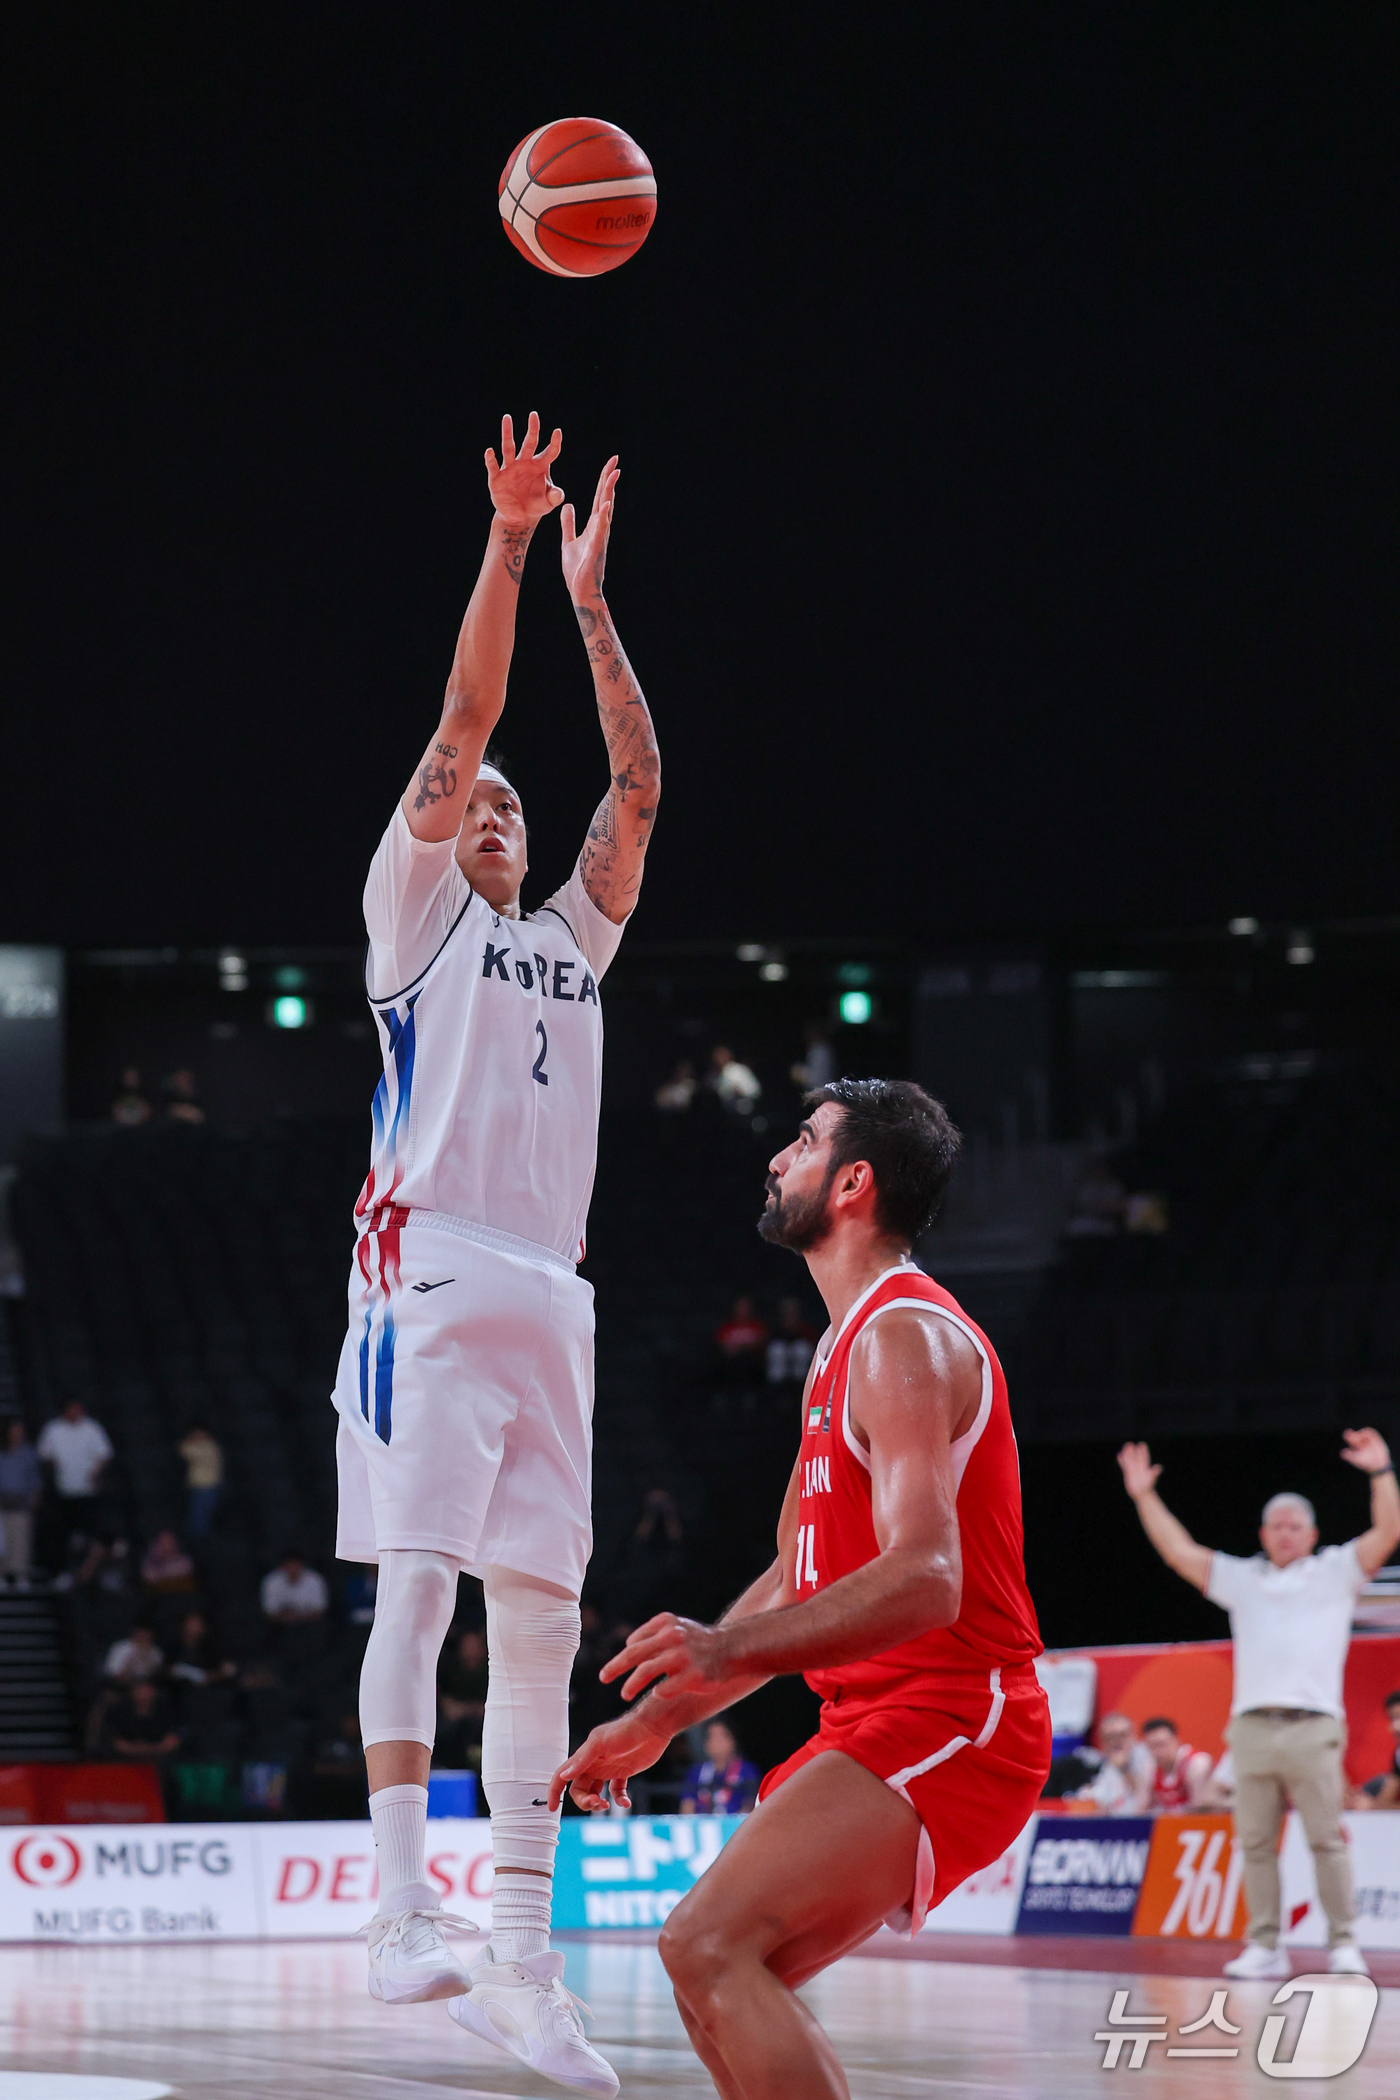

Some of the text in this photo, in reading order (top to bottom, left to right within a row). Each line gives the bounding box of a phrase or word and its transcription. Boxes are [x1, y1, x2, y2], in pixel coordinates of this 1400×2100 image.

[595, 211, 650, 230] molten
[435, 742, 458, 759] CDH
[482, 941, 598, 1007] KOREA
[532, 1019, 549, 1087] 2
[95, 1840, 232, 1876] MUFG
[581, 1818, 722, 1882] ニトリ
[274, 1850, 494, 1904] DESO
[1160, 1829, 1246, 1938] 361
[34, 1907, 219, 1934] MUFG Bank
[585, 1888, 692, 1927] NITO
